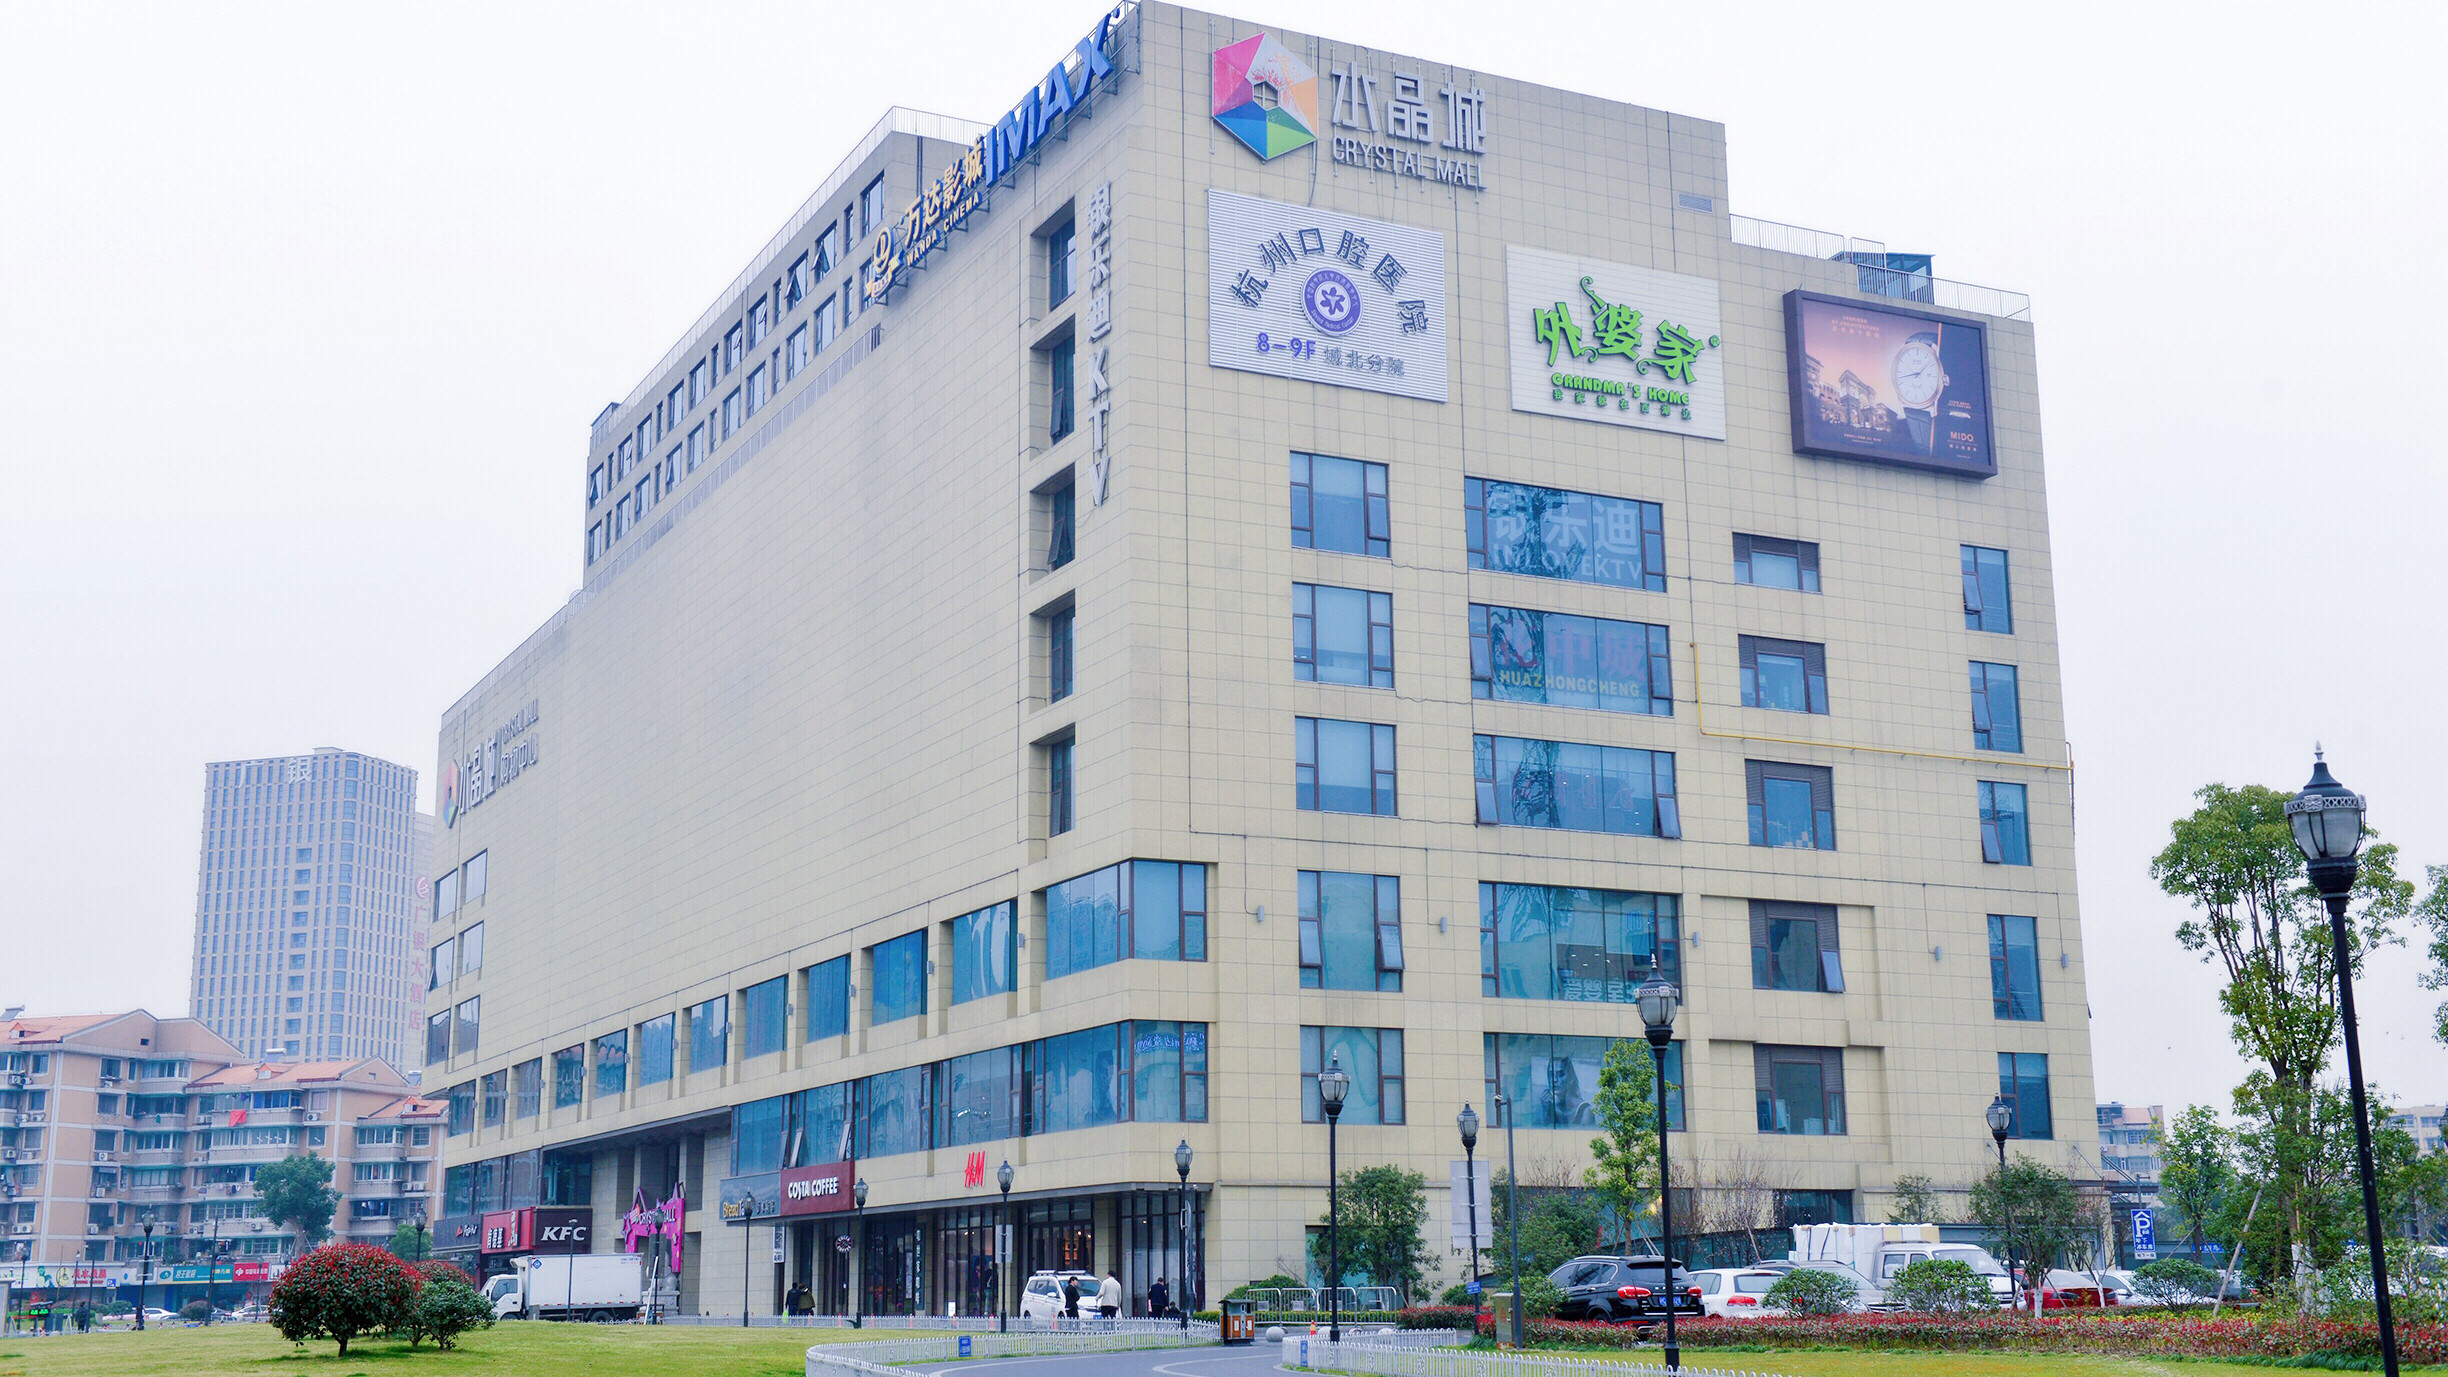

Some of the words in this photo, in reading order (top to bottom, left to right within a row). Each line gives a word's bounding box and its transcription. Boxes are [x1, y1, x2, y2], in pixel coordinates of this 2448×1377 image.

[986, 12, 1115, 188] IMAX
[1331, 61, 1487, 154] 水晶城
[1333, 136, 1425, 177] CRYSTAL
[1435, 154, 1487, 190] MALL
[903, 134, 985, 248] 万达影城
[907, 228, 939, 268] WANDA
[944, 191, 982, 233] CINEMA
[1231, 227, 1430, 334] 杭州口腔医院
[1533, 275, 1705, 385] 外婆家
[1323, 346, 1405, 377] 城北分院
[1551, 372, 1641, 398] GRANDMA'S
[1647, 387, 1690, 406] HOME
[1087, 346, 1110, 506] KTV
[1950, 431, 1974, 442] MIDO
[1499, 668, 1641, 698] HUAZHONGCHENG
[788, 1180, 810, 1200] COSTA
[811, 1177, 838, 1197] COFFEE
[964, 1151, 987, 1188] H&M
[541, 1226, 587, 1241] KFC
[2134, 1218, 2151, 1237] P
